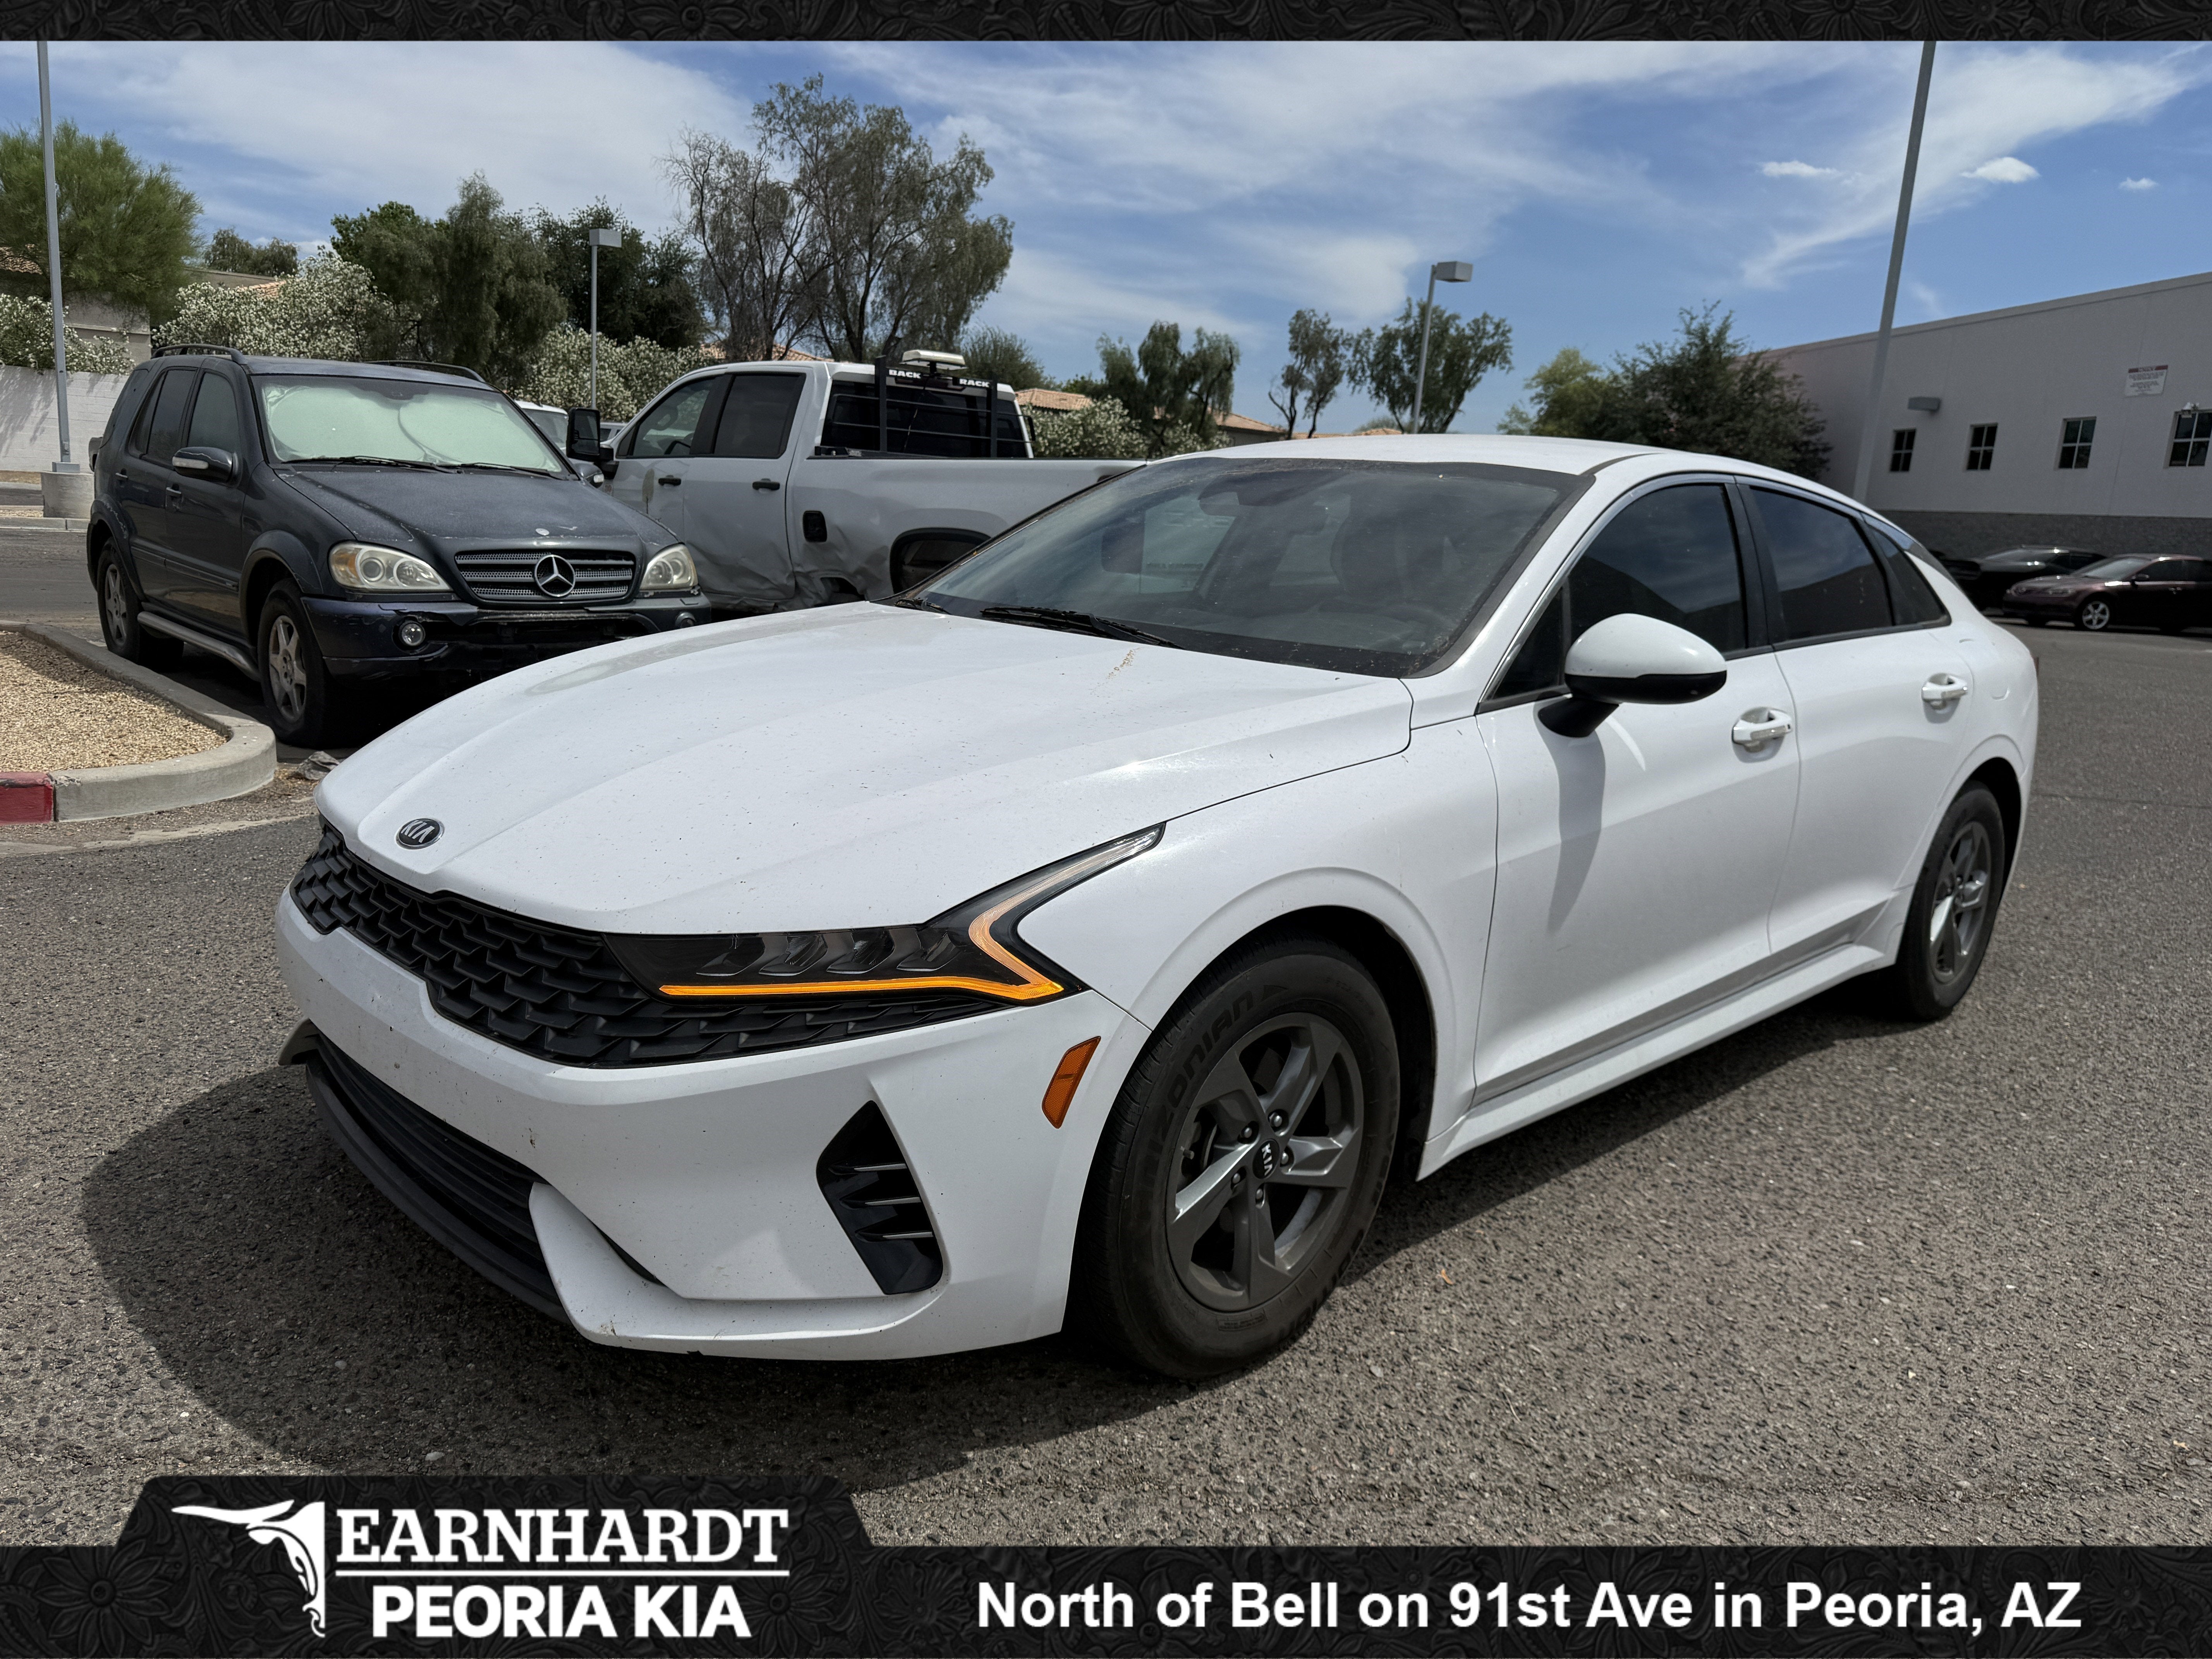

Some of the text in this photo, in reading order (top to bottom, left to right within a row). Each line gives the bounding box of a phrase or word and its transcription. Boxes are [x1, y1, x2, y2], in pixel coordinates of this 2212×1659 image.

[889, 369, 989, 387] BACK RACK
[401, 820, 435, 843] KIA
[1261, 1143, 1273, 1176] KIA
